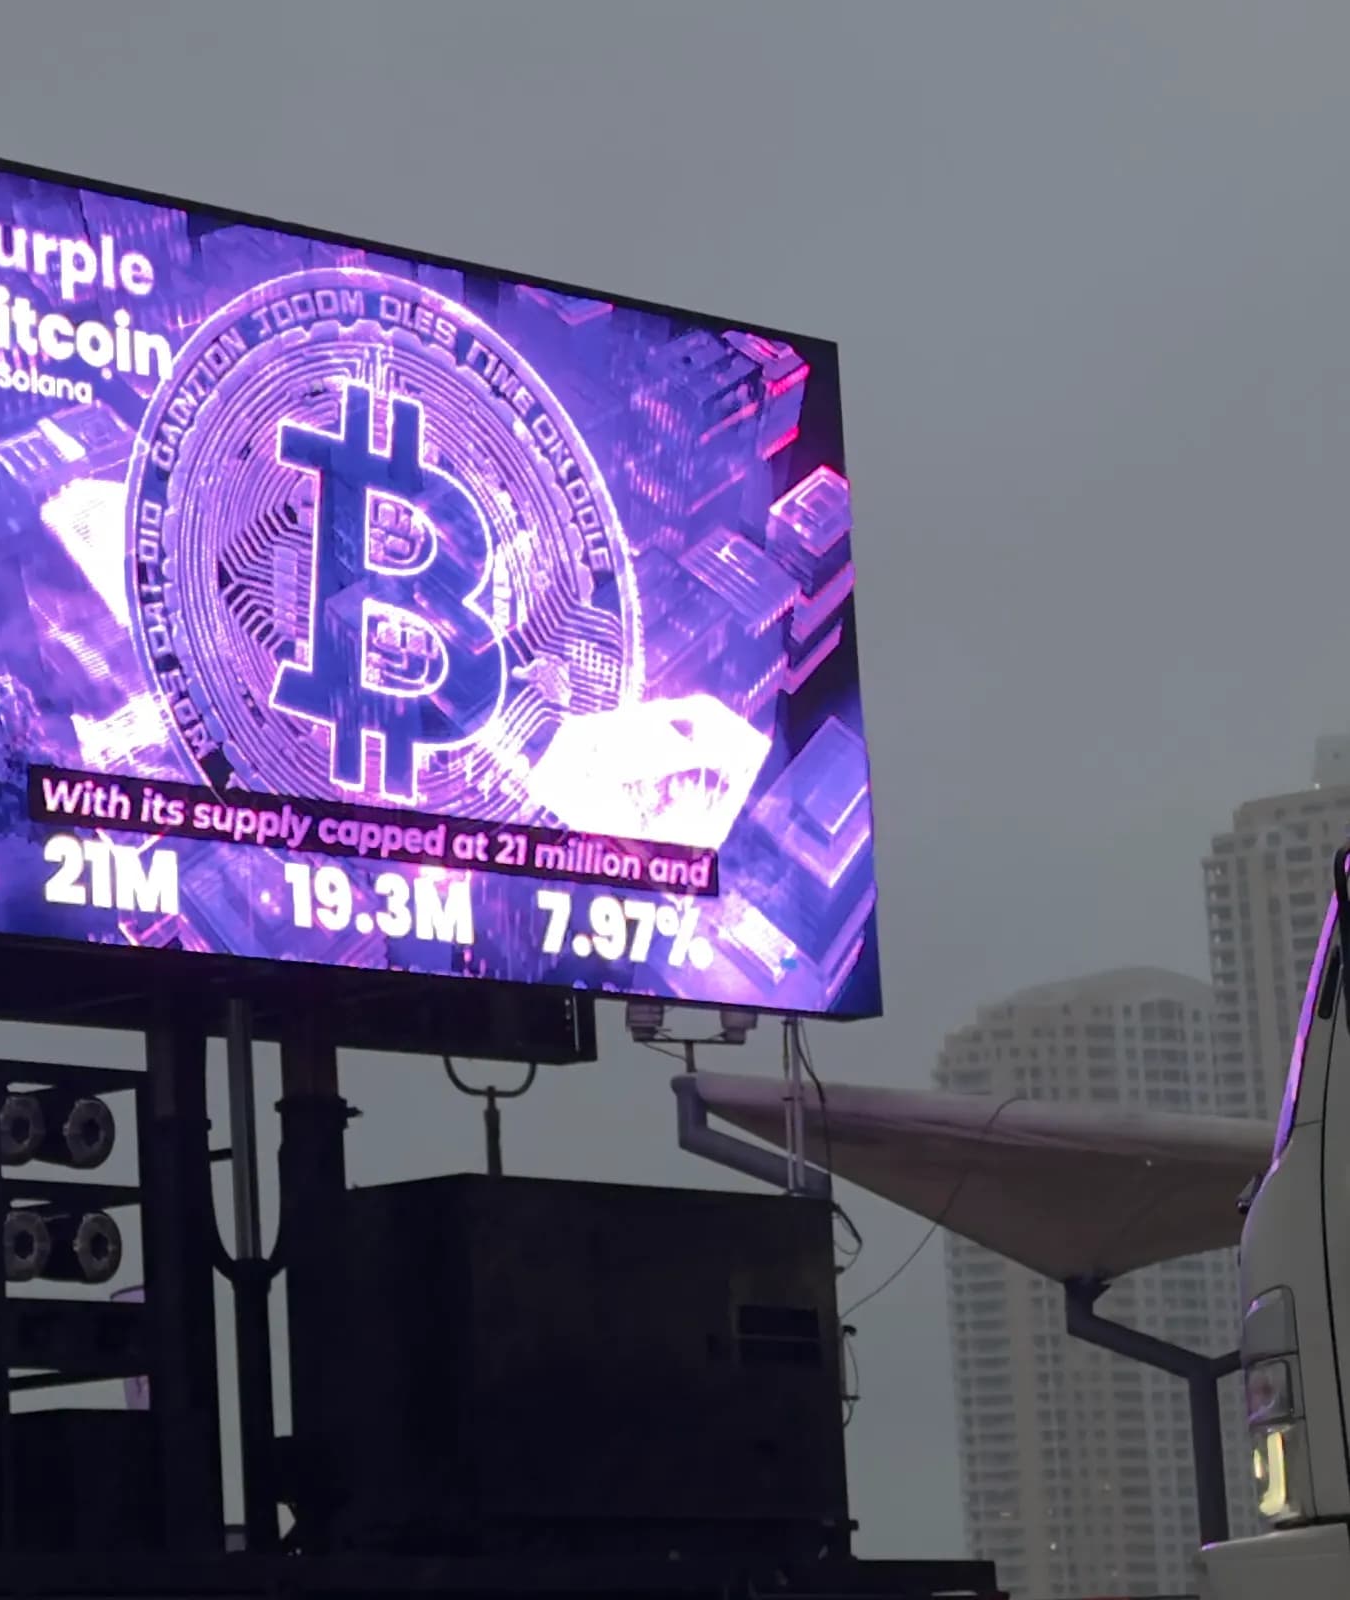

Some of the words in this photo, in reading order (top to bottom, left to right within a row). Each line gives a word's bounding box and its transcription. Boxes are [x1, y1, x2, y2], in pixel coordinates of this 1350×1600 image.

[42, 778, 131, 821] With
[140, 787, 185, 826] its
[192, 803, 313, 848] supply
[318, 817, 447, 859] capped
[452, 832, 490, 863] at
[494, 832, 527, 866] 21
[534, 837, 642, 881] million
[648, 854, 710, 889] and
[43, 833, 179, 915] 21M
[284, 862, 475, 945] 19.3M
[536, 889, 715, 971] 7.97%
